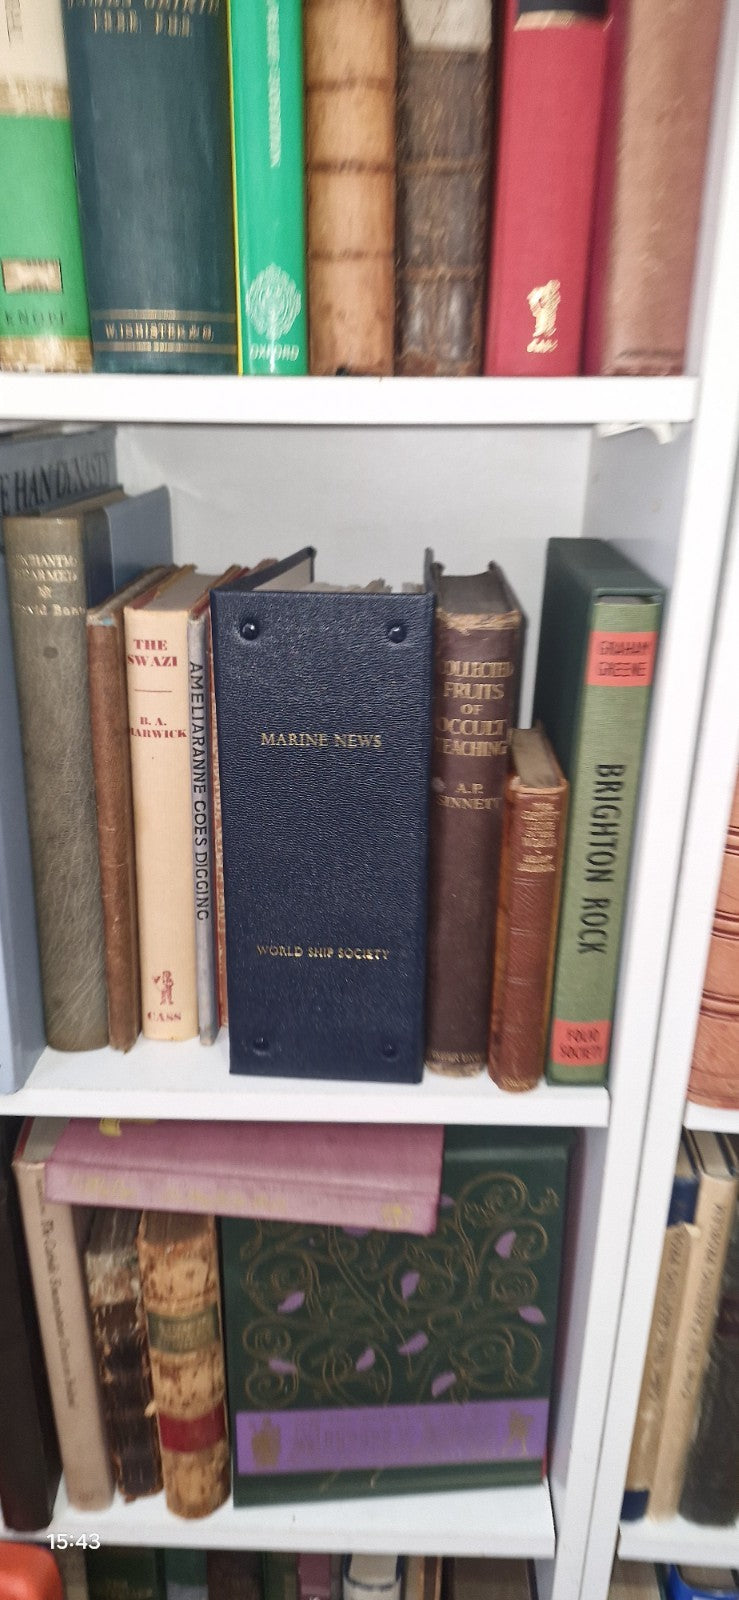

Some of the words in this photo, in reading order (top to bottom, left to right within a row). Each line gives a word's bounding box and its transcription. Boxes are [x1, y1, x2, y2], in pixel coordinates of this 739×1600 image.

[133, 639, 168, 651] THE
[600, 641, 649, 655] GRAHAM
[127, 654, 178, 667] SWAZI
[441, 661, 514, 678] OLLECTED
[598, 661, 648, 677] GREENE
[443, 682, 505, 700] FRUITS
[459, 703, 484, 715] OF
[155, 717, 167, 726] A.
[189, 660, 207, 794] AMELIARANNE
[437, 717, 507, 736] OCCULT
[260, 732, 329, 747] MARINE
[333, 733, 382, 748] NEWS
[193, 800, 208, 846] GOES
[584, 764, 627, 884] BRIGHTON
[195, 851, 210, 921] DIGGING
[576, 896, 612, 956] ROCK
[256, 945, 304, 957] WORLD
[307, 947, 334, 958] SHIP
[337, 948, 390, 960] SOCIETY
